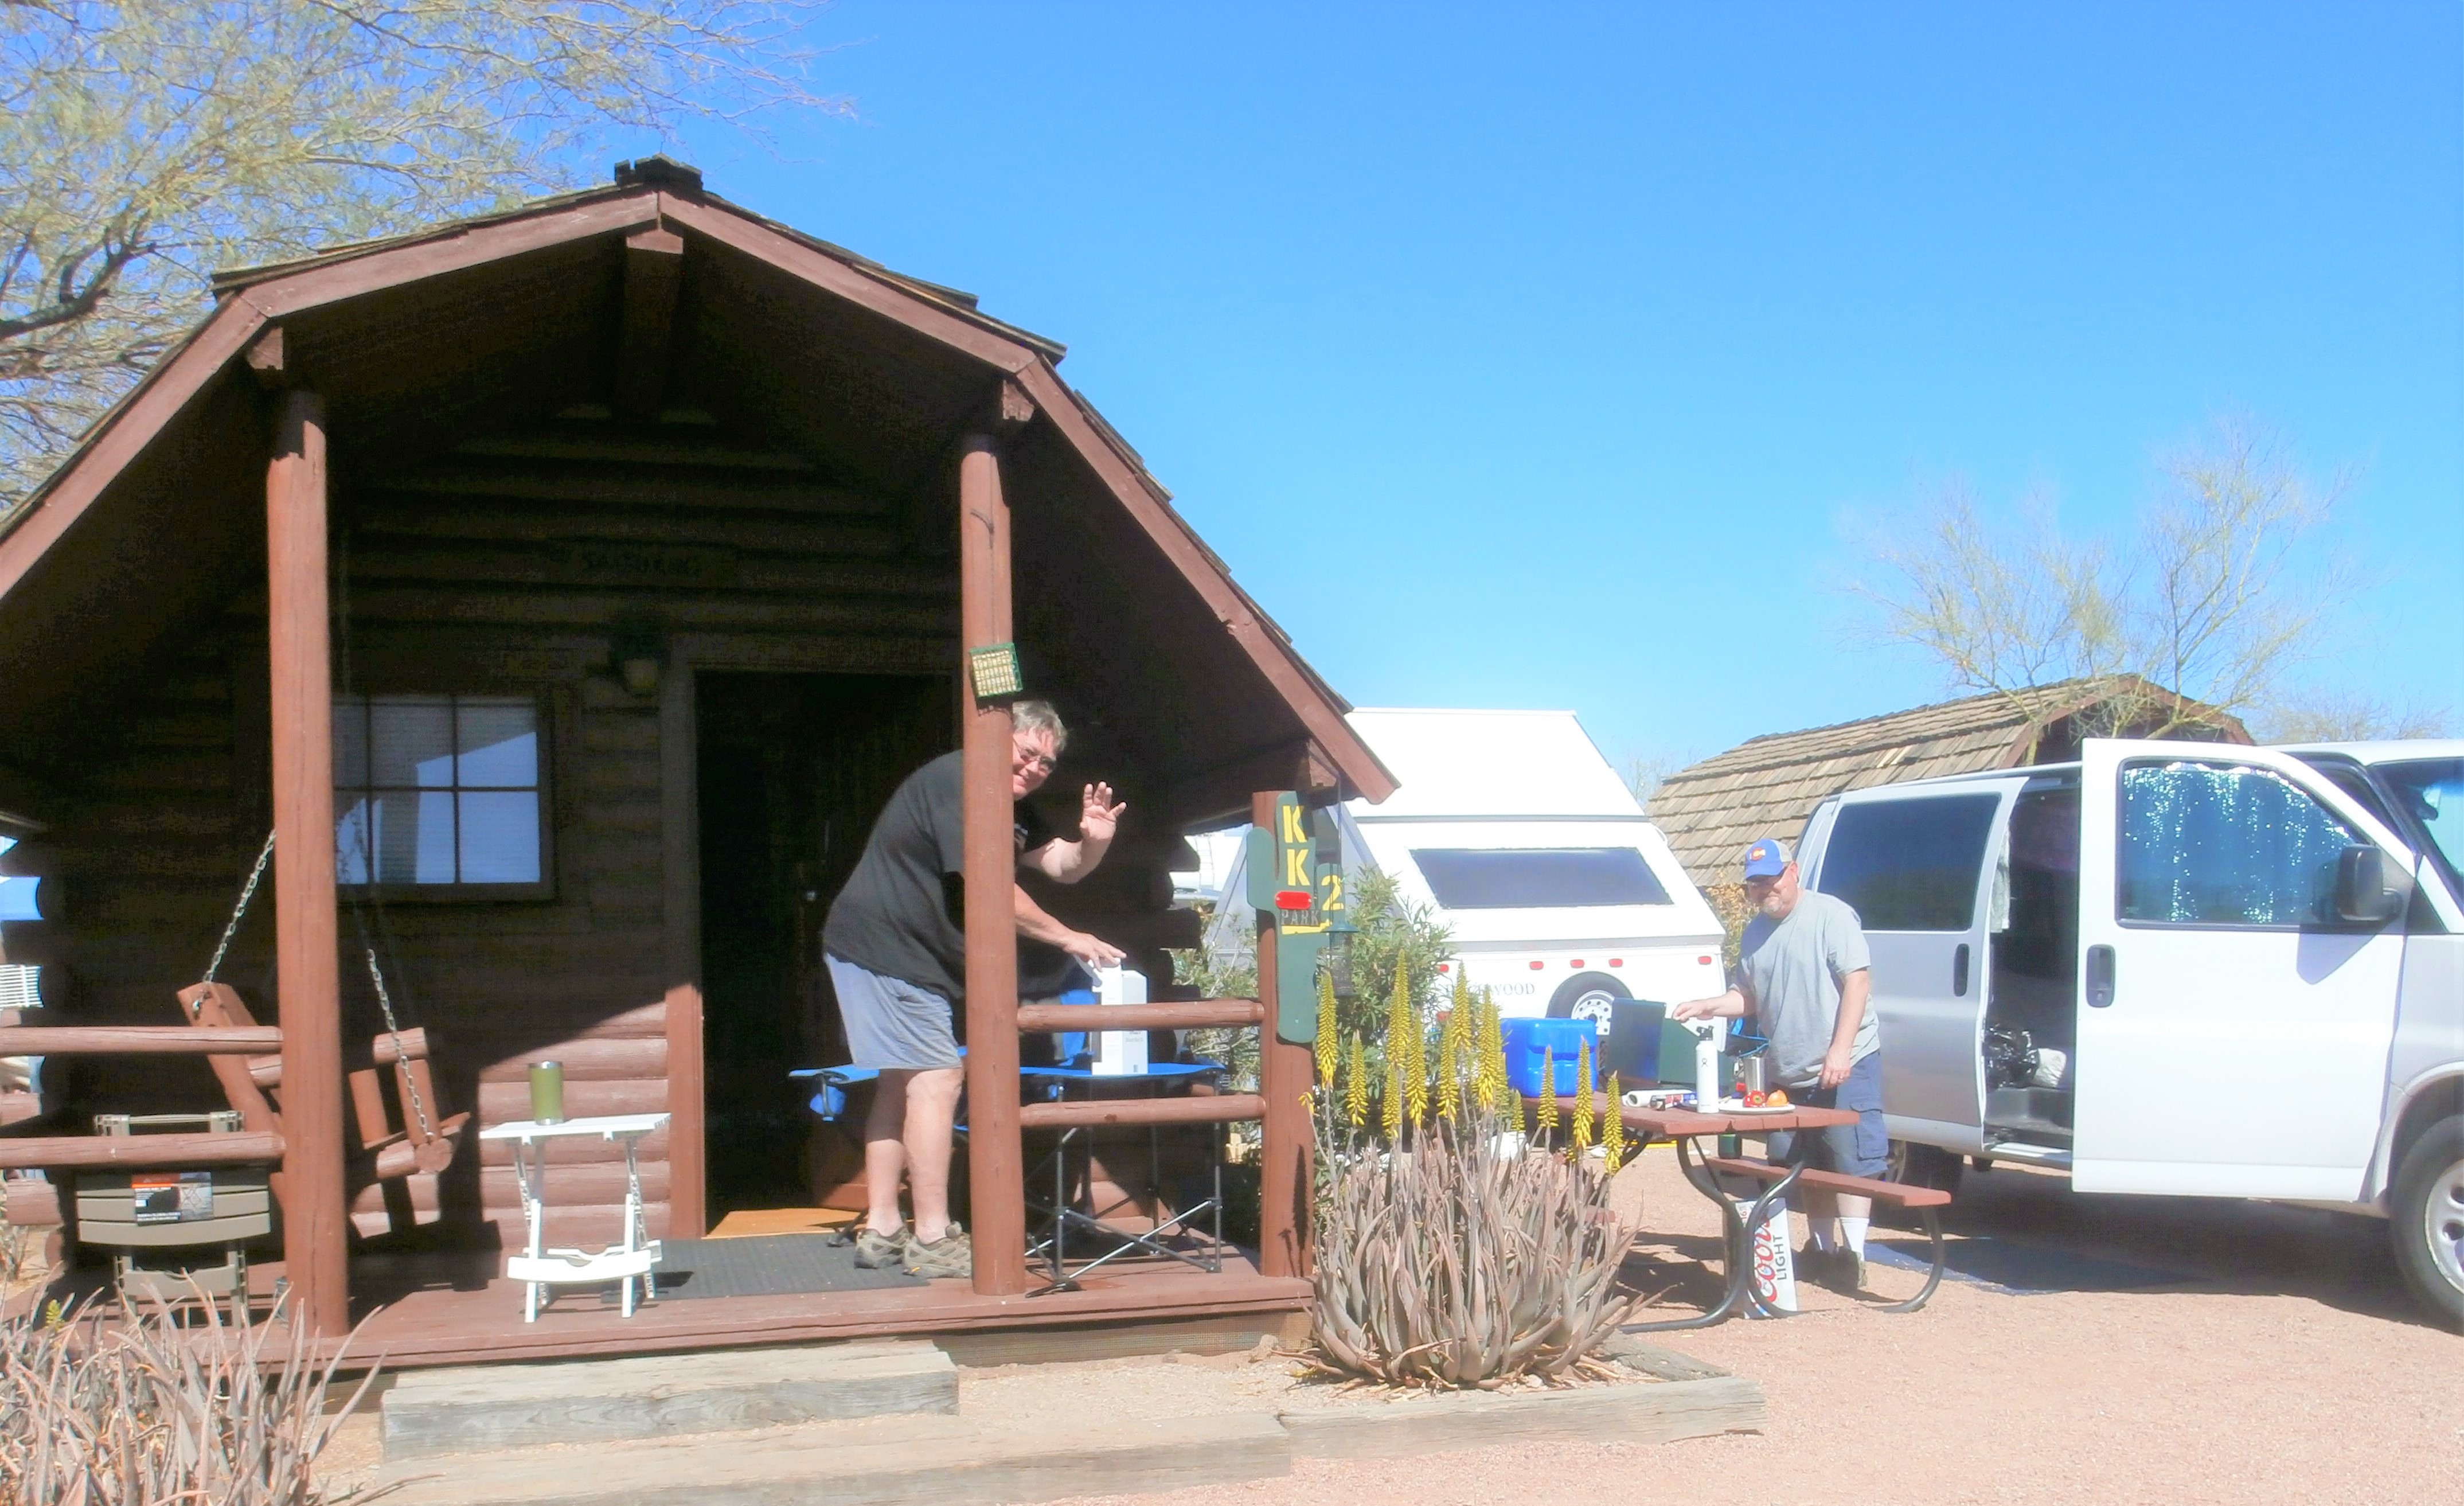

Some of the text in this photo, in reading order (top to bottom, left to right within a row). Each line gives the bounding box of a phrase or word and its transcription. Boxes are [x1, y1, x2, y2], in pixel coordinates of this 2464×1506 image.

[1321, 875, 1344, 911] 2
[1280, 910, 1320, 925] PARK
[1773, 1235, 1787, 1281] LIGHT
